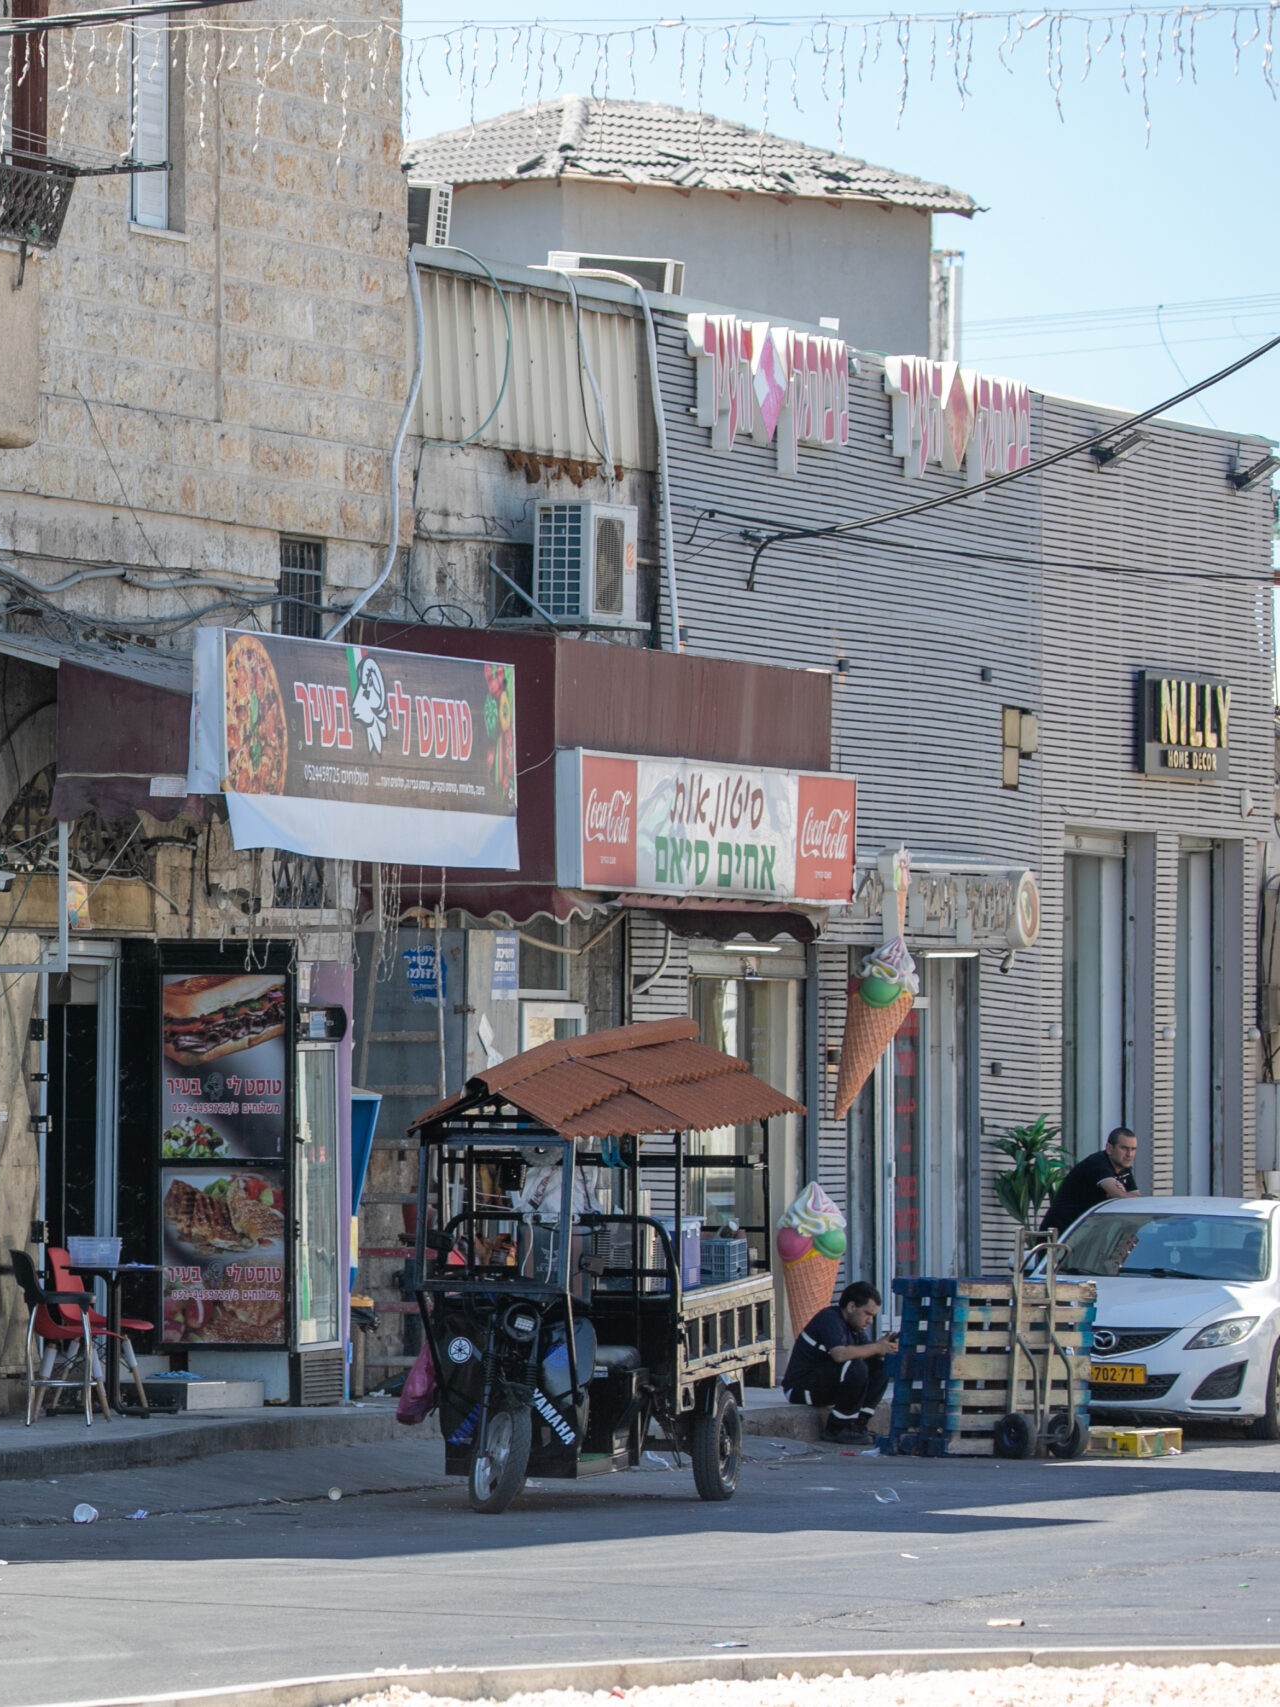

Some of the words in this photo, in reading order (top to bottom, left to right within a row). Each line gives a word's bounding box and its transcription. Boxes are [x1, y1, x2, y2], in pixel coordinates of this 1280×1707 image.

[293, 681, 353, 750] בעיר
[387, 680, 412, 756] לי
[1161, 678, 1231, 748] NILLY
[416, 694, 473, 762] טוסט
[1168, 750, 1189, 769] HOME
[1192, 751, 1217, 771] DECOR
[654, 835, 710, 887] סיאם
[716, 841, 777, 891] אחים
[166, 1077, 202, 1096] בעיר
[226, 1075, 242, 1096] לי
[245, 1077, 283, 1096] טוסט
[241, 1101, 282, 1115] משלוחים
[166, 1265, 202, 1283] בעיר
[226, 1262, 242, 1283] לי
[245, 1265, 283, 1283] טוסט
[241, 1287, 281, 1301] משלוחים
[532, 1387, 577, 1446] YAMAHA
